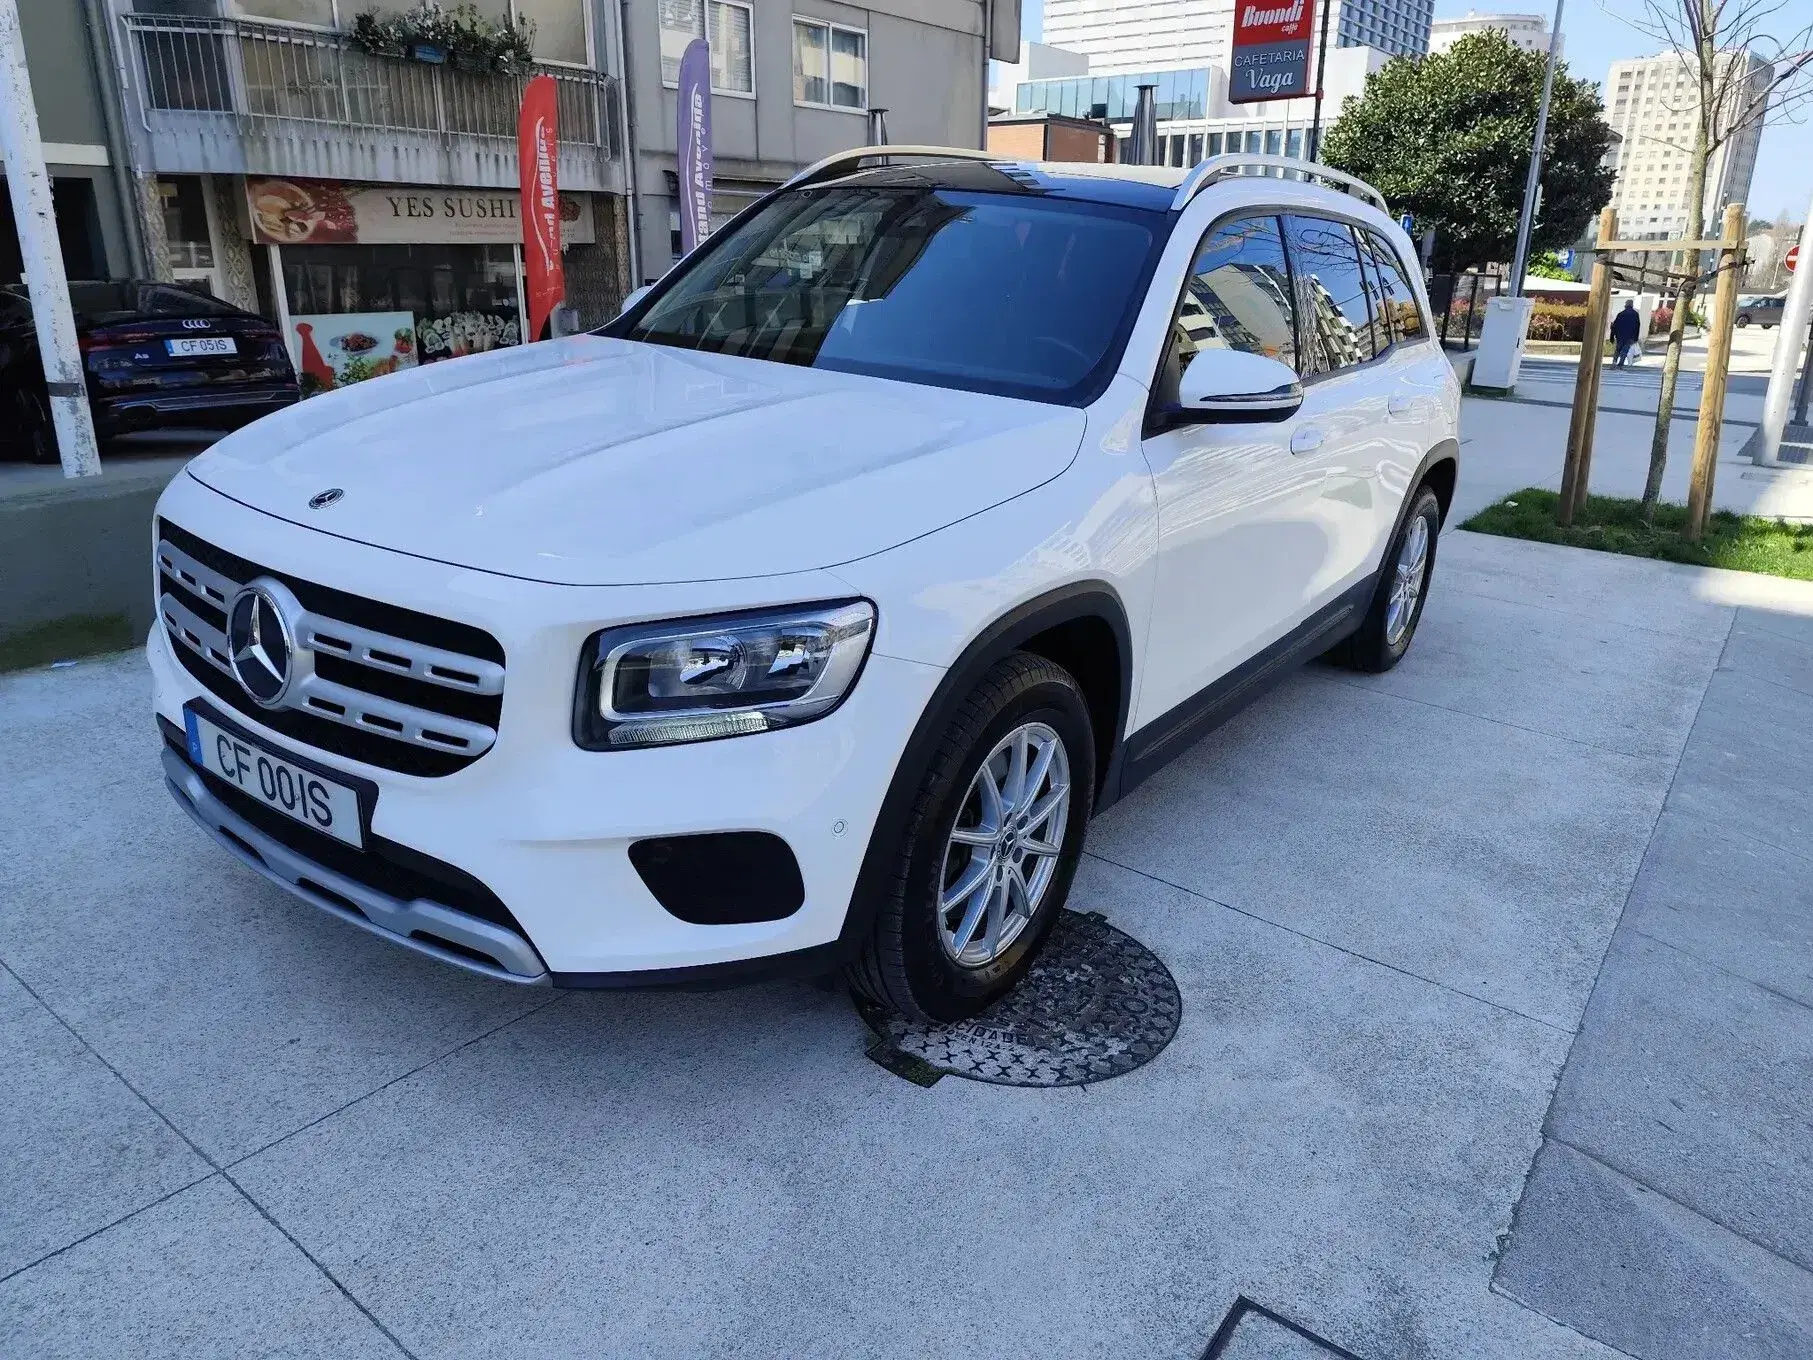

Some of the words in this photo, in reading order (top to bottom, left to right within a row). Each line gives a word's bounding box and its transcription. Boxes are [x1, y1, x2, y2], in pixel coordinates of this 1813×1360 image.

[1234, 49, 1305, 67] CAFETARIA
[1245, 68, 1295, 94] Vaga
[386, 197, 435, 218] YES
[444, 198, 517, 219] SUSHI
[181, 341, 197, 352] CF
[216, 734, 250, 785] CF
